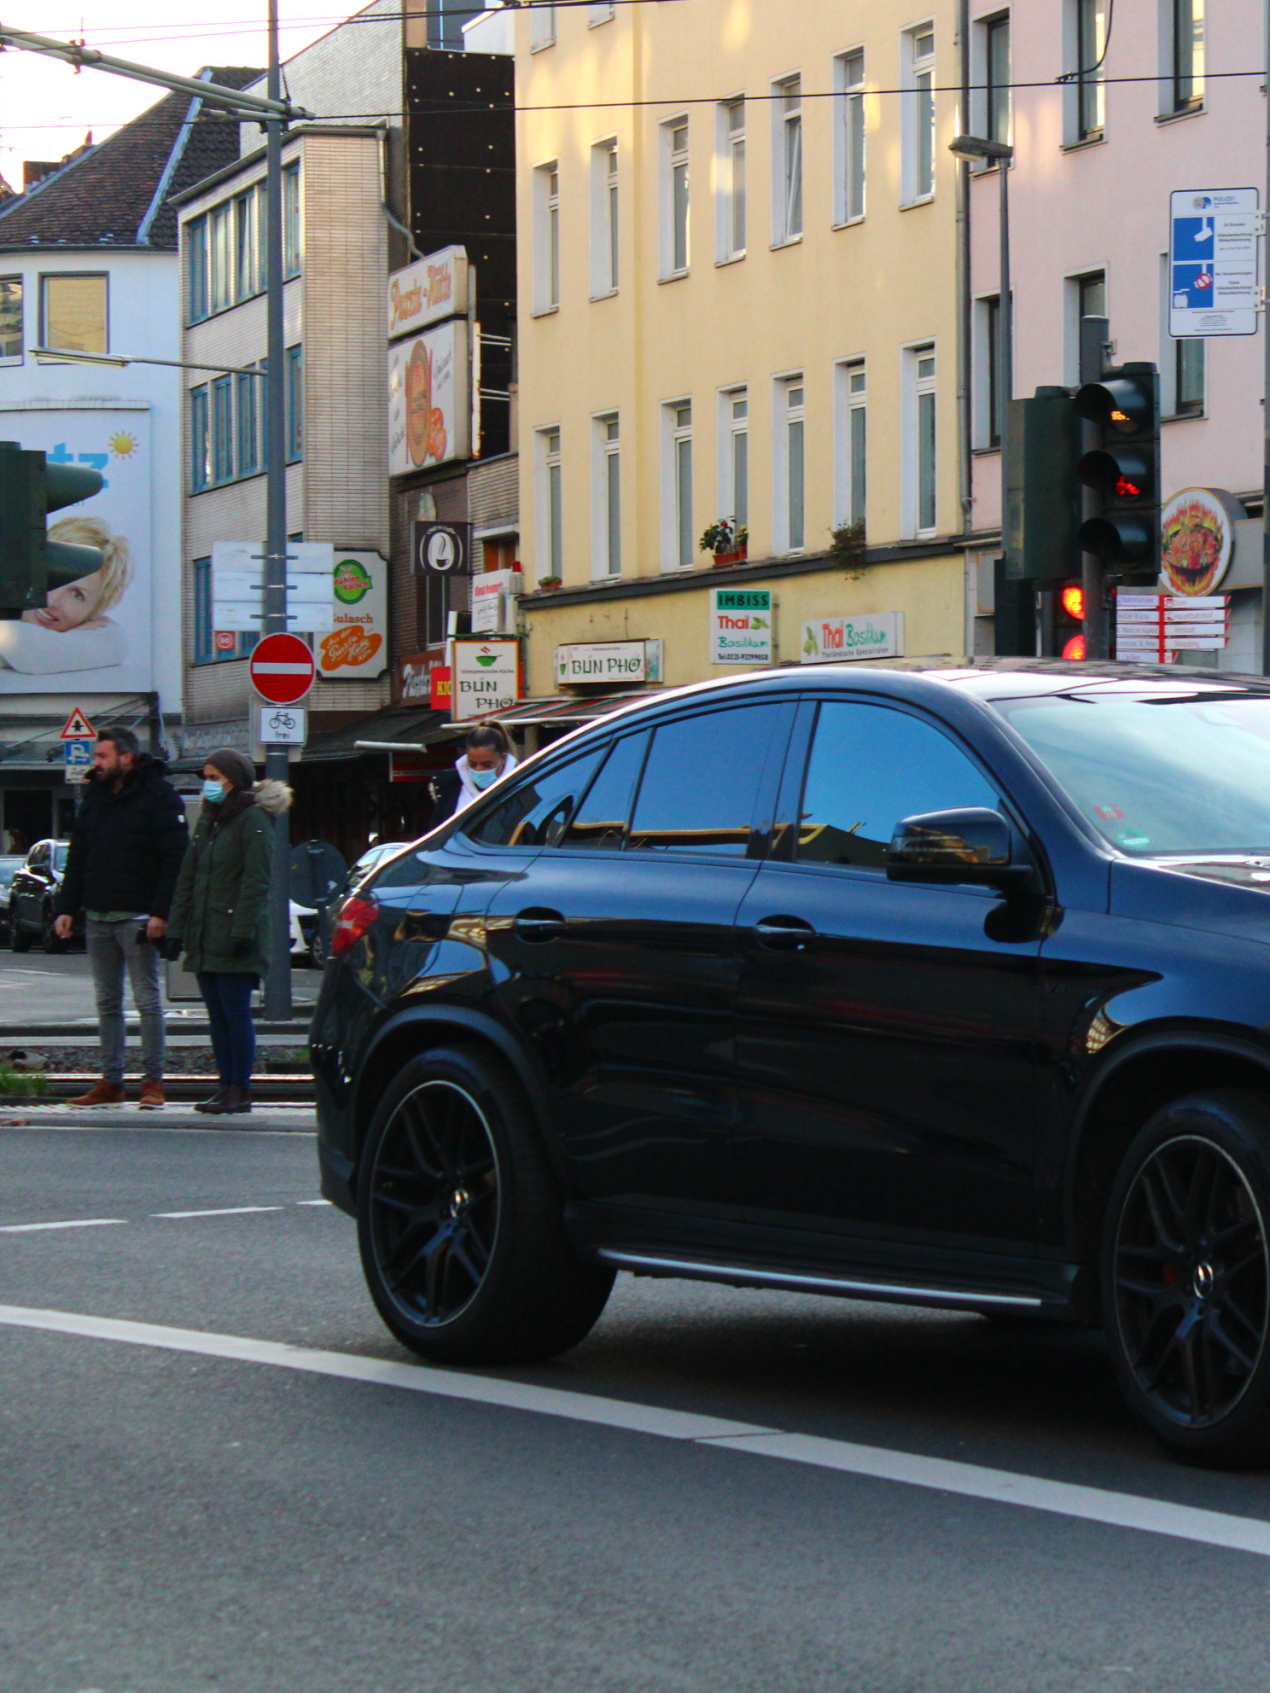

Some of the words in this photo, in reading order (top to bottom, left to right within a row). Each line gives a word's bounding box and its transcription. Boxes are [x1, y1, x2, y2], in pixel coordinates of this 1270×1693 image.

[718, 594, 769, 607] IMBISS
[333, 613, 374, 624] ulasch
[717, 615, 750, 630] Thai
[822, 620, 844, 650] Thai
[845, 622, 888, 648] Basilikum
[717, 636, 769, 649] Basilikum
[276, 731, 290, 739] frei
